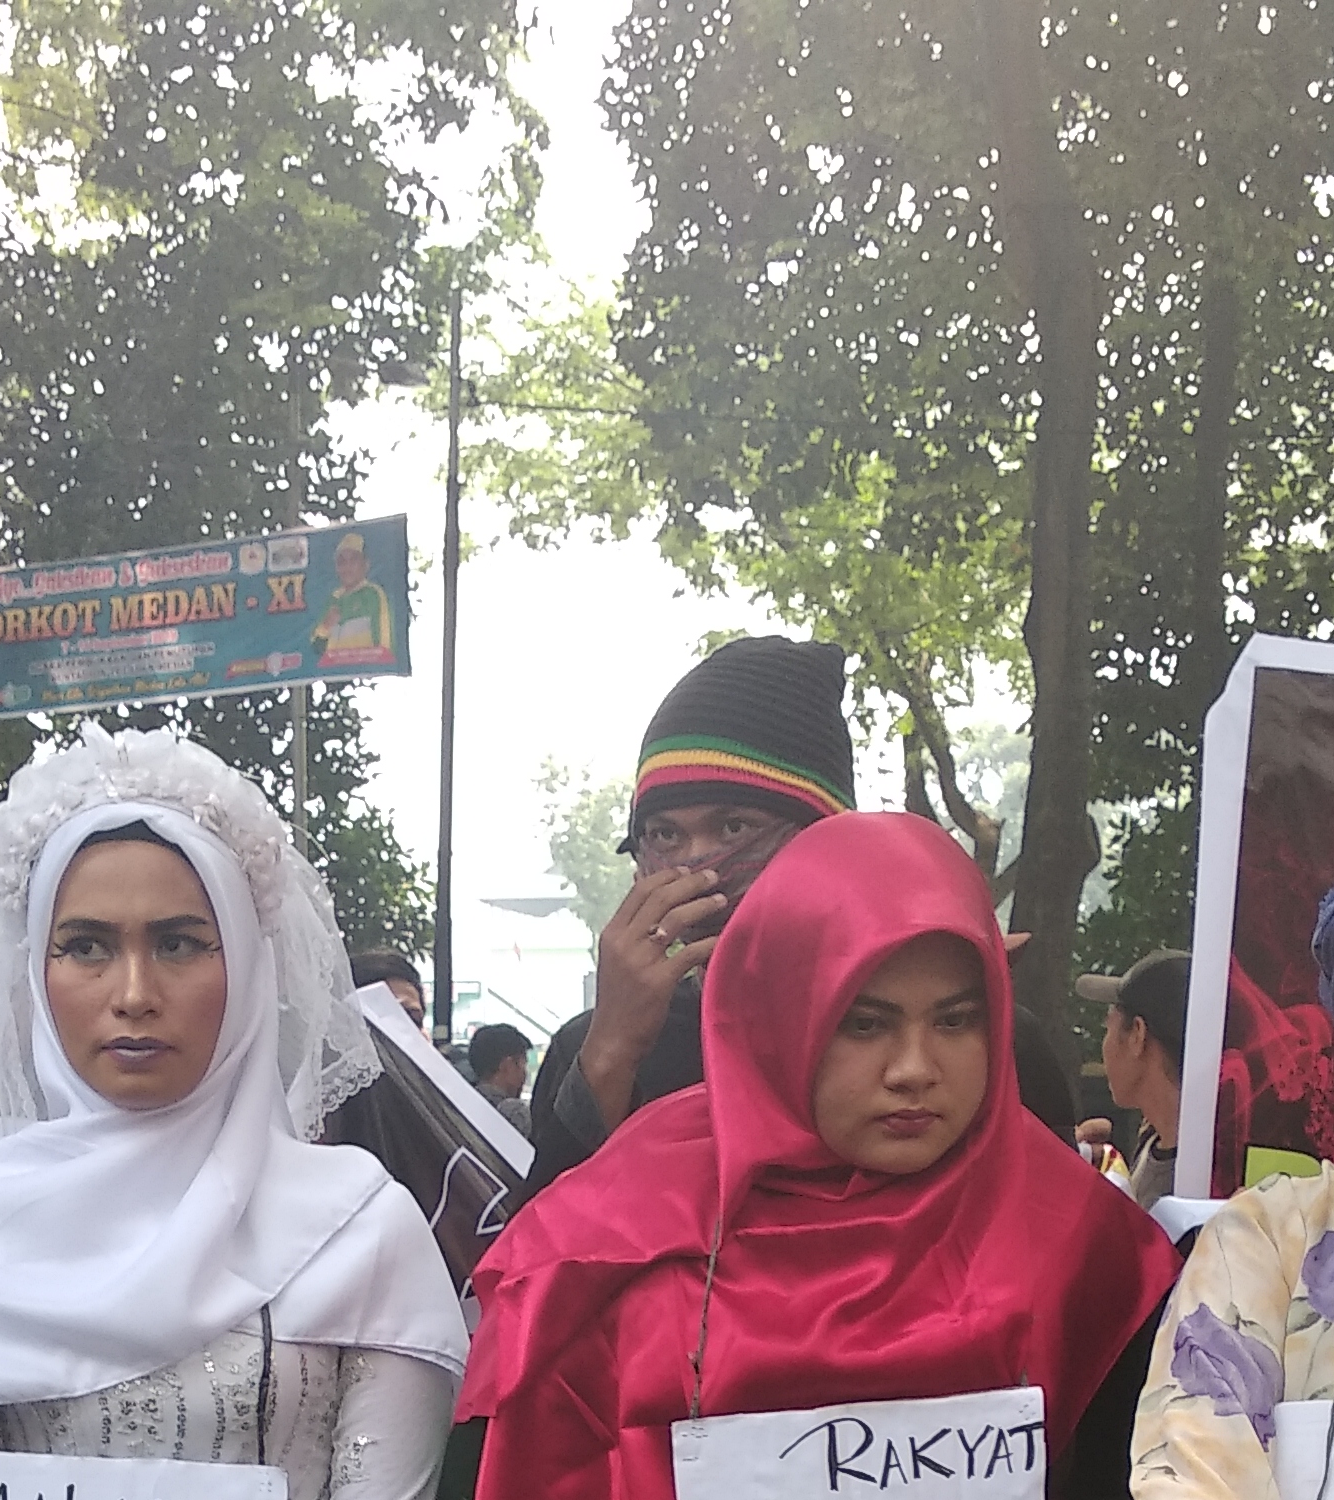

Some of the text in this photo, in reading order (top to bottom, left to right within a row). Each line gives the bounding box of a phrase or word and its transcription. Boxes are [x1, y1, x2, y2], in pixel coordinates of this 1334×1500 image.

[109, 582, 237, 632] MEDAN
[267, 573, 308, 614] XI
[778, 1416, 1045, 1491] RAKYAT
